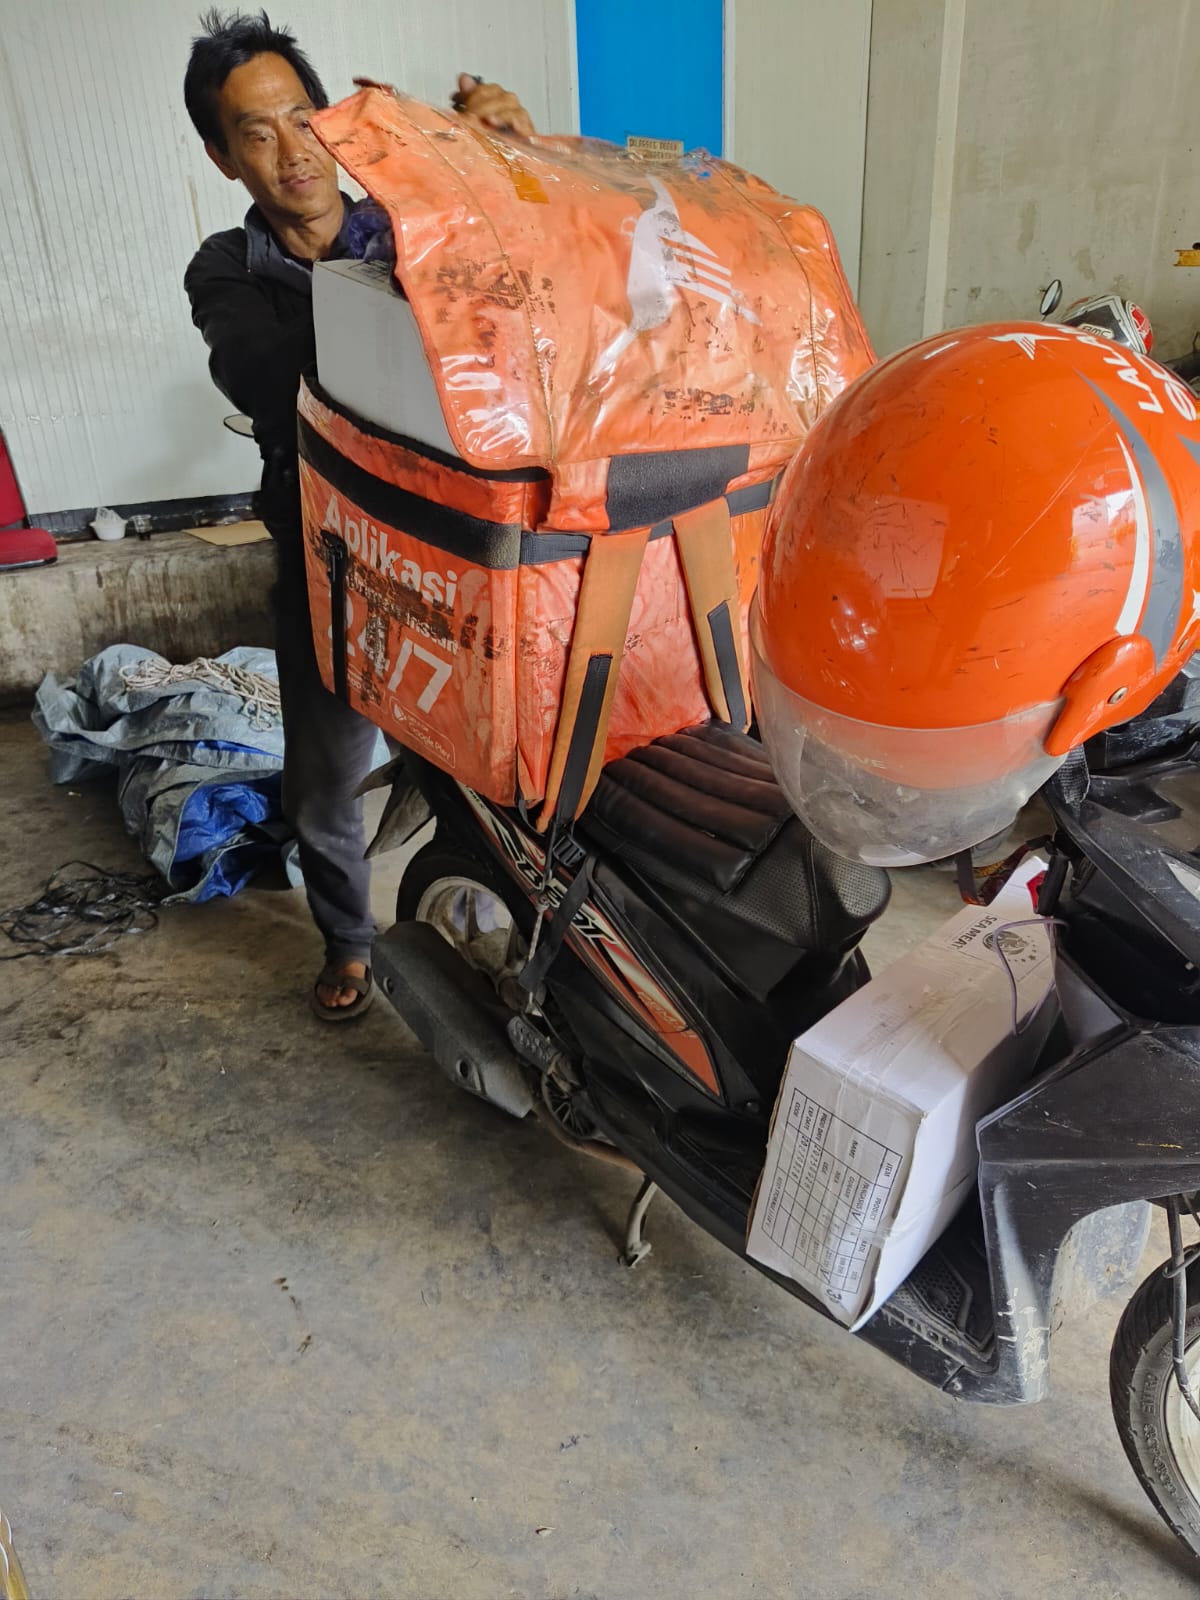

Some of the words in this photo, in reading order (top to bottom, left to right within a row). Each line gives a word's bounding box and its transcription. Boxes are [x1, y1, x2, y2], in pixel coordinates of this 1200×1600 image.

[323, 494, 458, 608] Aplikasi
[974, 915, 998, 929] SEA
[951, 927, 981, 949] MEAT
